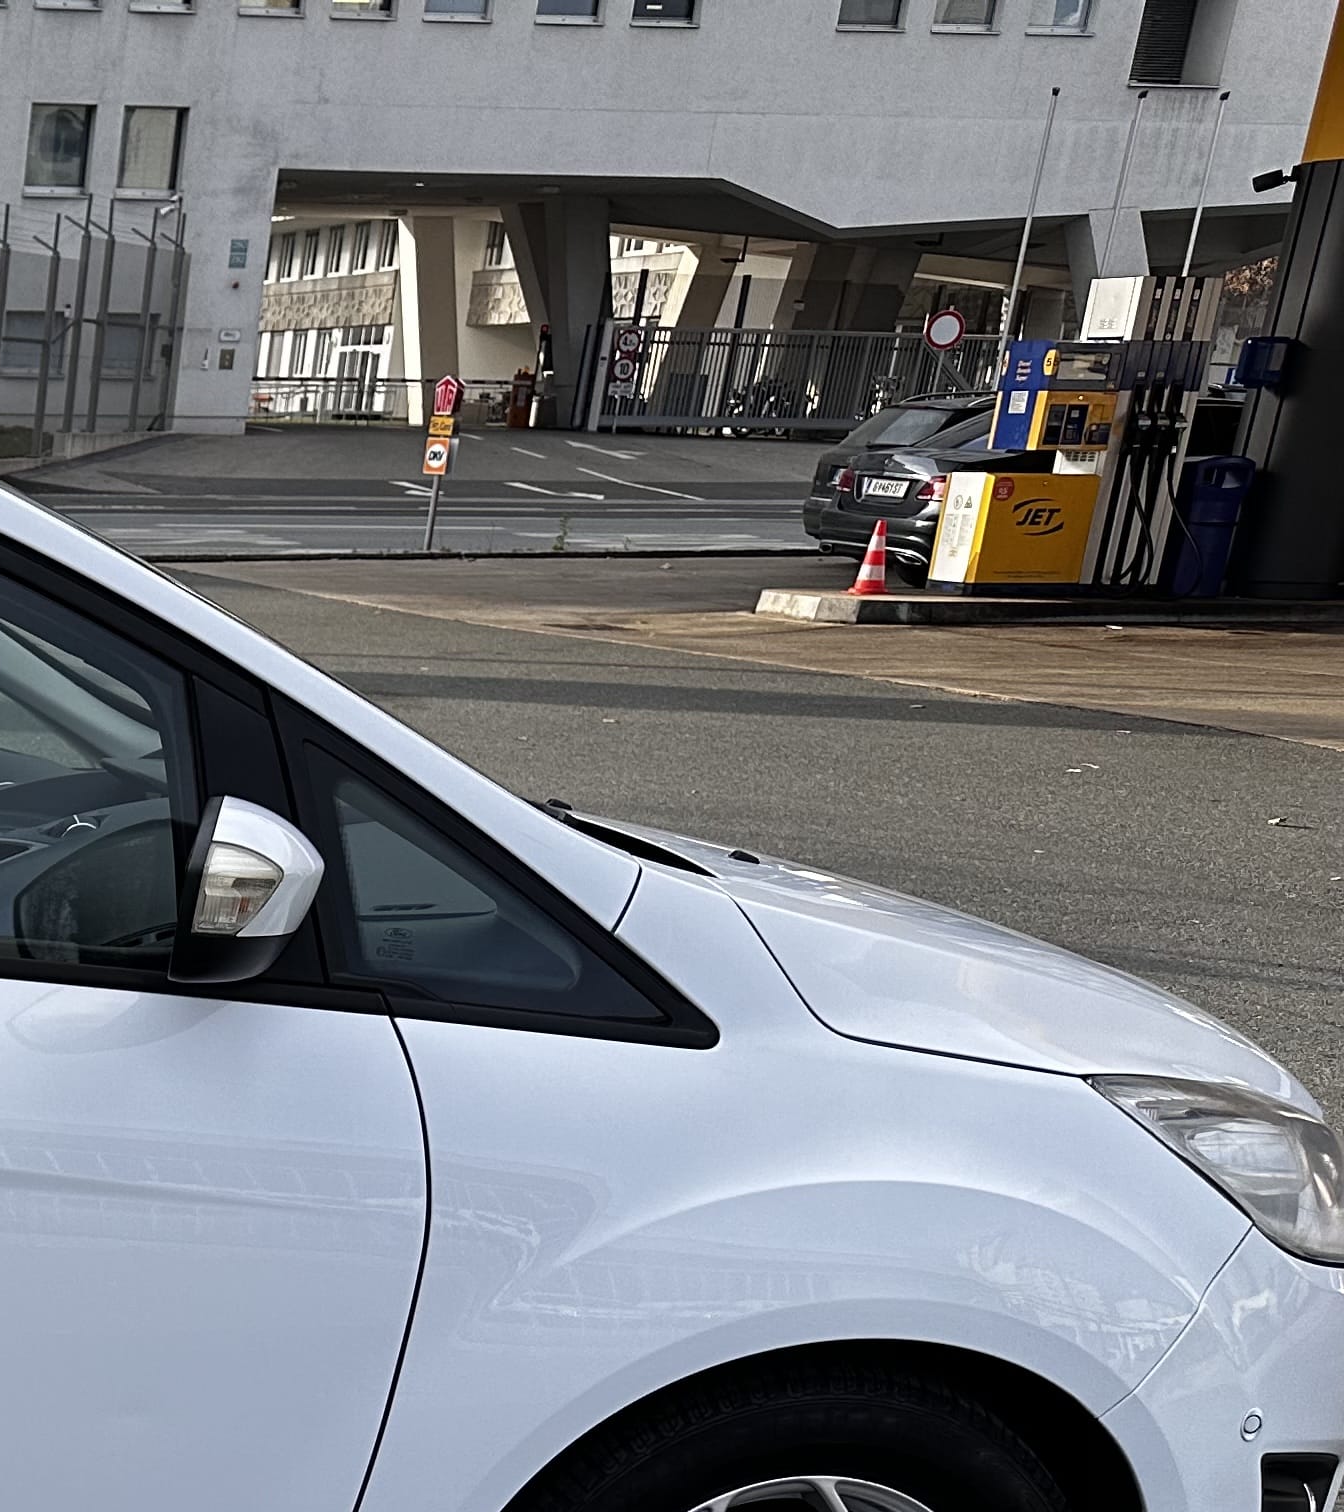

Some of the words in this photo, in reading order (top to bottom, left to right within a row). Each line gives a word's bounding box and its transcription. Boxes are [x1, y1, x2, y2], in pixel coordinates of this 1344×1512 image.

[619, 362, 630, 376] 10
[428, 450, 445, 461] DKV
[1015, 508, 1062, 526] JET
